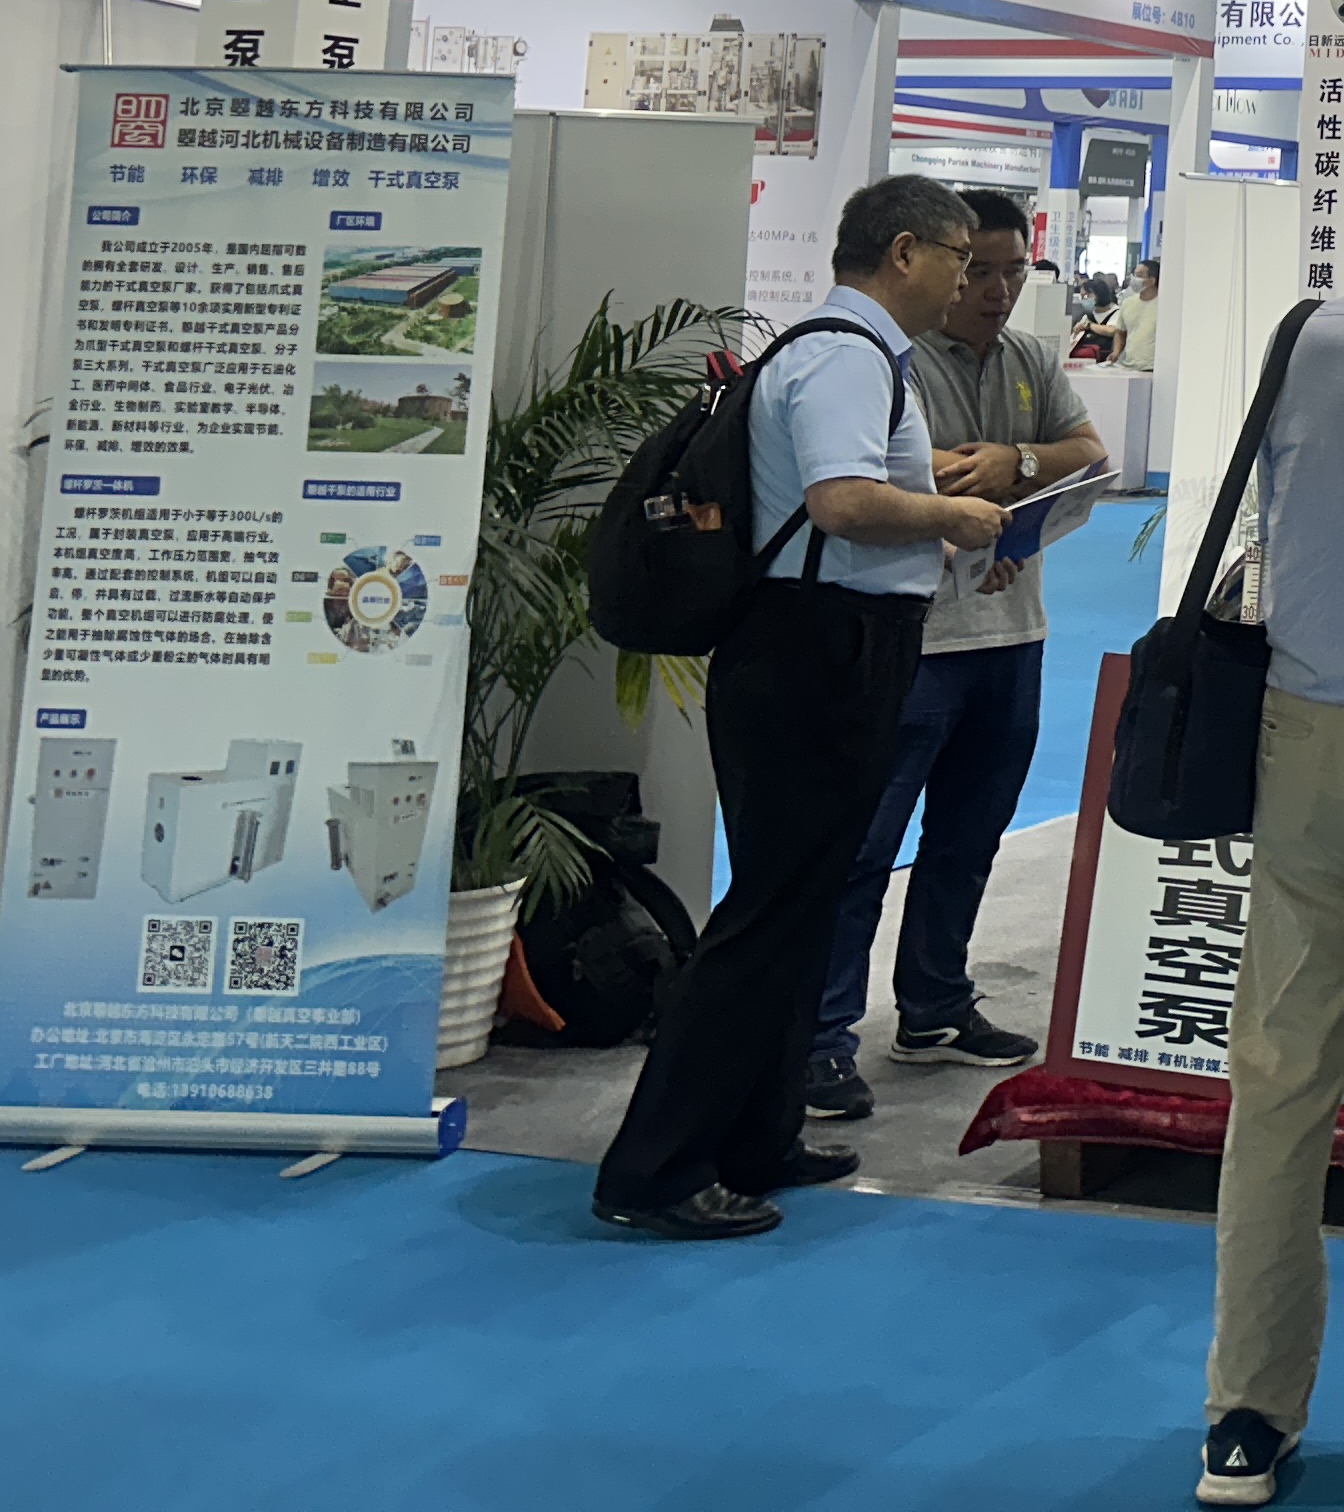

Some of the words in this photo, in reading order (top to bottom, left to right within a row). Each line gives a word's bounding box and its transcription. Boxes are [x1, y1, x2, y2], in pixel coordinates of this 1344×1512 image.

[1213, 32, 1268, 48] ipment
[109, 164, 145, 184] 节能
[181, 166, 218, 186] 环保
[248, 167, 283, 187] 减排
[312, 168, 350, 188] 增效
[367, 170, 461, 191] 干式真空泵
[1307, 77, 1344, 289] 活性碳纤维膜
[1242, 605, 1255, 620] 30
[1079, 1040, 1110, 1059] 节能
[1118, 1046, 1149, 1063] 减排
